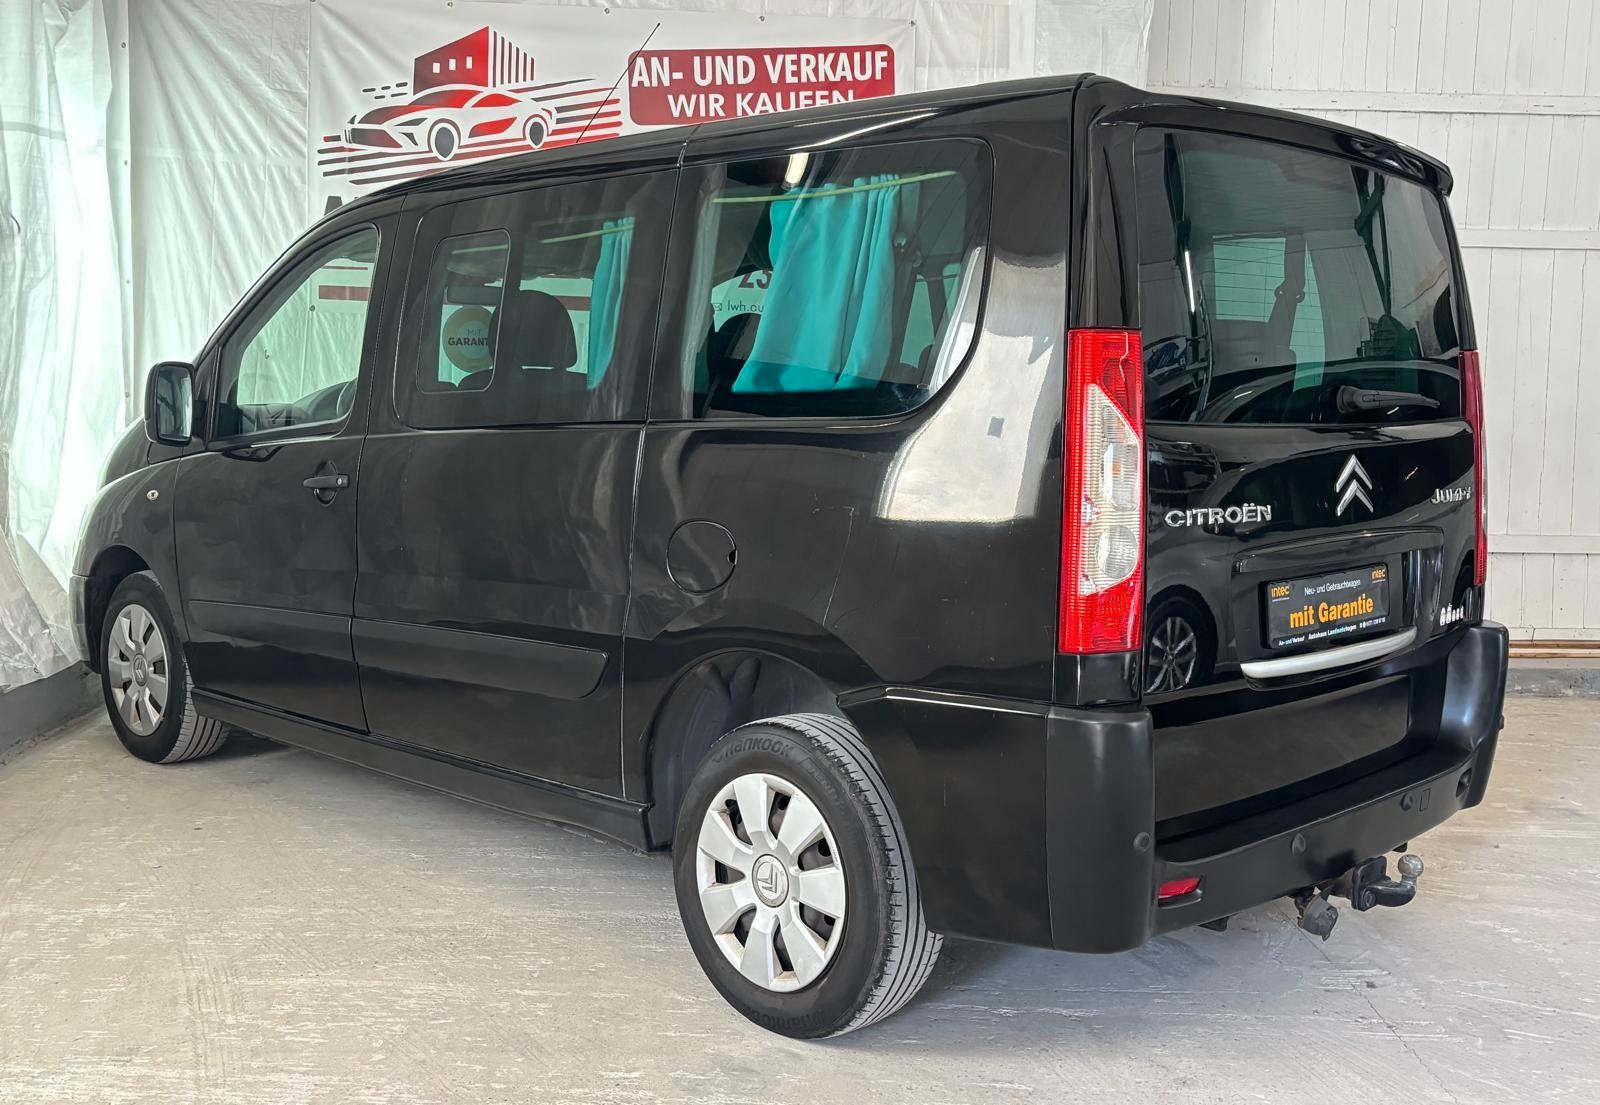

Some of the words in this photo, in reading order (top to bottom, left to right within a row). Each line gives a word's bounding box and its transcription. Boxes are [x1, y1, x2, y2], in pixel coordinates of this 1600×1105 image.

[631, 56, 684, 88] AN-
[693, 54, 756, 87] UND
[763, 50, 889, 85] VERKAUF
[667, 93, 726, 118] WIR
[1164, 503, 1272, 528] CITROËN
[1304, 586, 1316, 597] Neu-
[1316, 583, 1326, 593] und
[1326, 579, 1361, 593] Gebrauchtwagen
[1290, 605, 1315, 628] mit
[1318, 593, 1374, 623] Garantie
